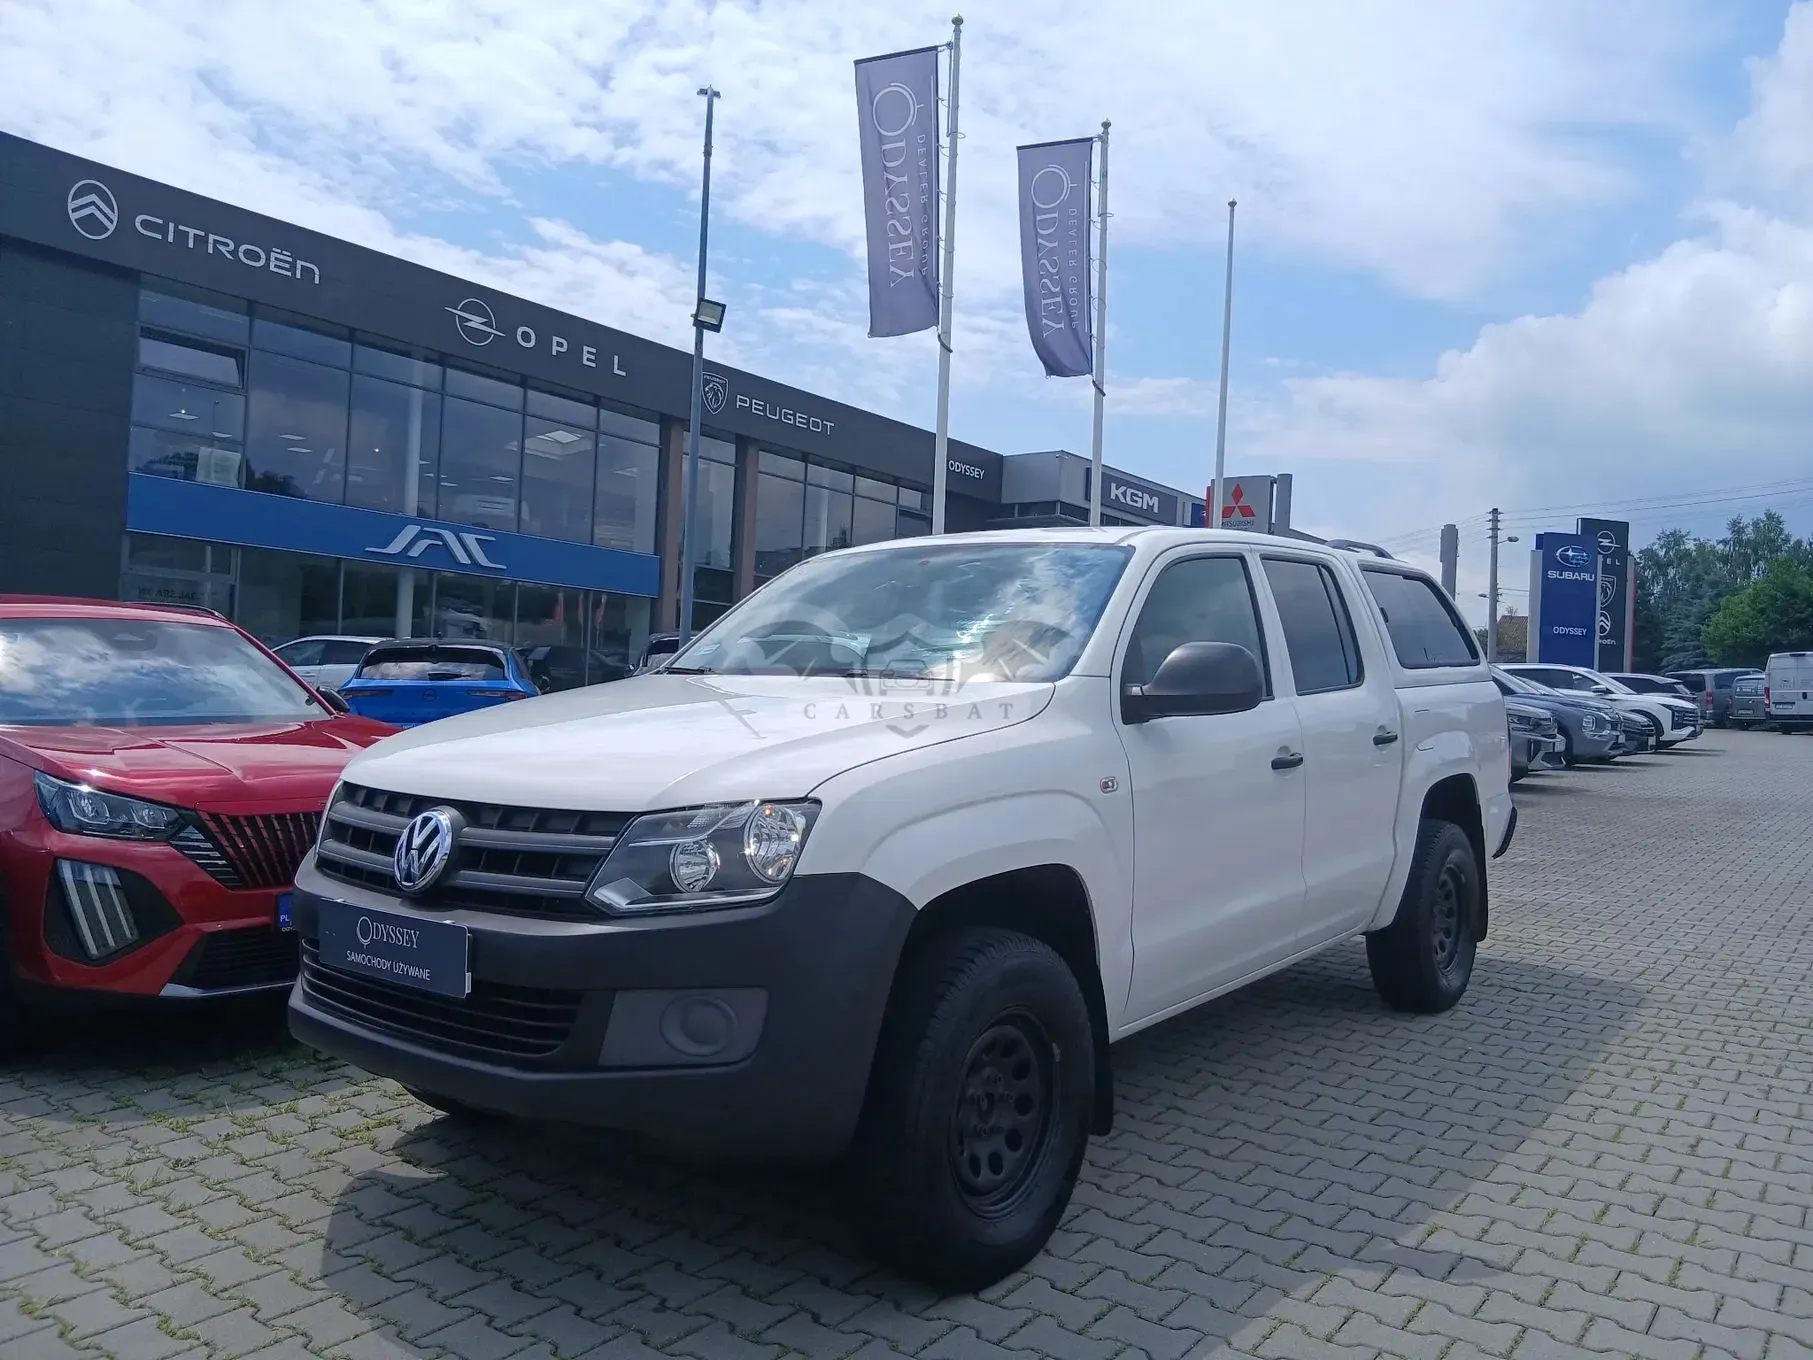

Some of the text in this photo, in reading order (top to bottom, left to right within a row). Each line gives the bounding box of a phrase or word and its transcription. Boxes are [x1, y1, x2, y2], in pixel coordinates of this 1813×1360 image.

[516, 326, 626, 377] OPEL
[736, 394, 834, 436] PEUGEOT
[948, 460, 985, 480] ODYSSEY
[1109, 482, 1159, 513] KGM
[1547, 570, 1595, 581] SUBARU
[1553, 626, 1587, 636] ODYSSEY
[280, 914, 290, 922] PL
[356, 916, 420, 949] ODYSSEY
[346, 950, 431, 981] SAMOCHODY UŻYWANE
